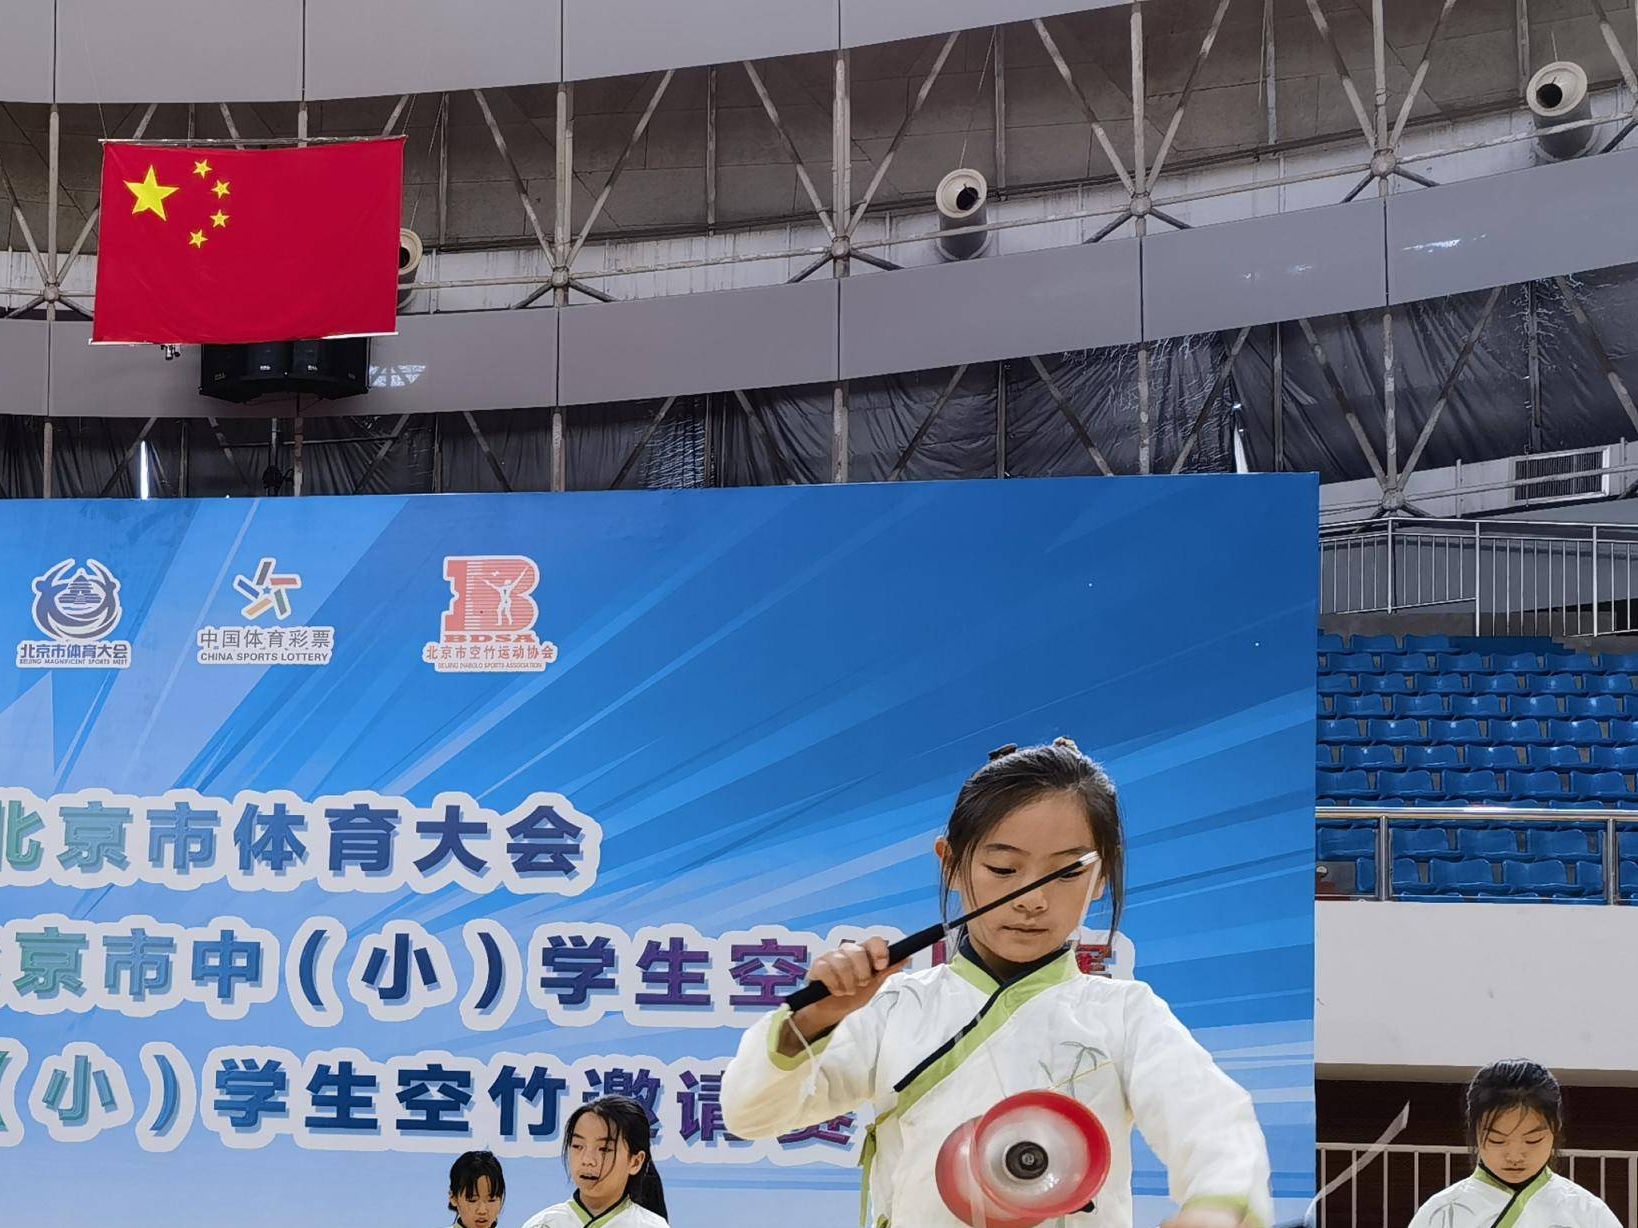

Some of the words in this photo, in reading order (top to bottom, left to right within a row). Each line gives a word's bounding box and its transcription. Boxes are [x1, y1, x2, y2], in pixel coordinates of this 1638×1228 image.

[201, 629, 330, 648] 中国体育彩票
[444, 634, 536, 643] BDSA
[20, 644, 128, 659] 北京市体育大会
[201, 653, 233, 661] CHINA
[237, 653, 278, 661] SPORTS
[280, 653, 328, 661] LOTTERY
[426, 645, 554, 660] 北京市空竹运动协会
